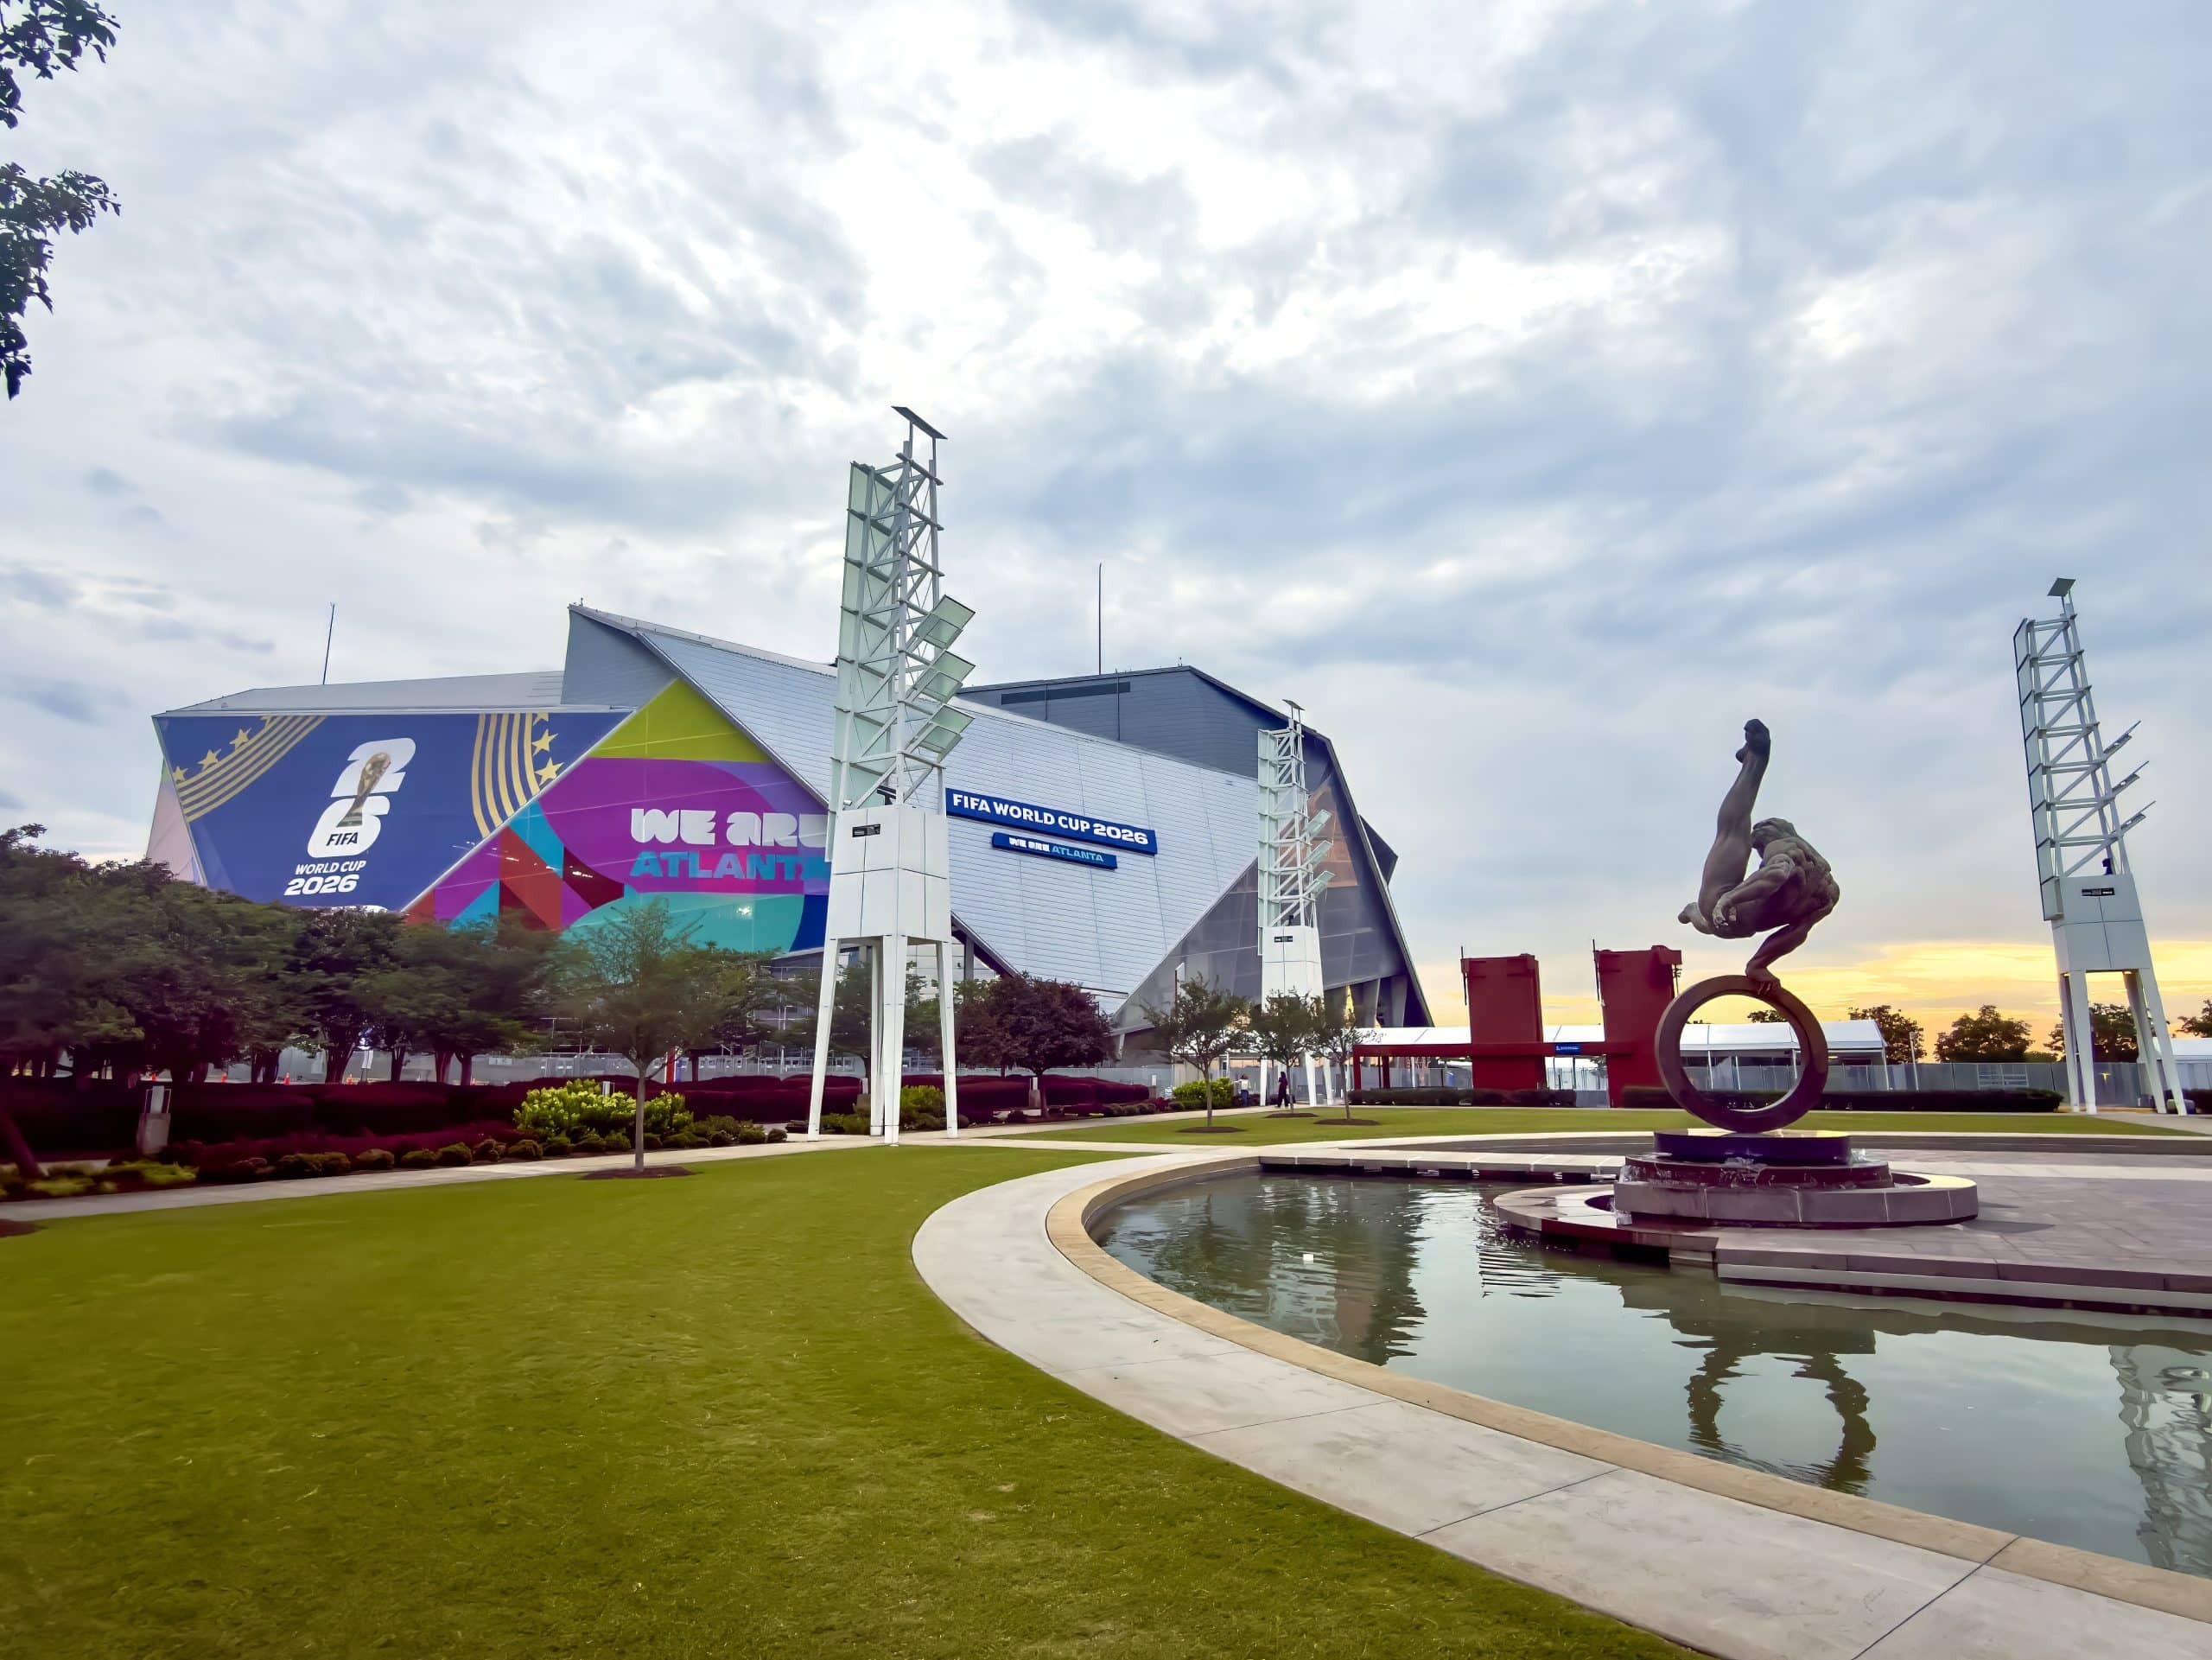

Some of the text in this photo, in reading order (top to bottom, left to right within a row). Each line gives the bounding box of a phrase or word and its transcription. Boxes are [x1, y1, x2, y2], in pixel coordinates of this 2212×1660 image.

[630, 808, 716, 845] WE
[952, 793, 1148, 845] FIFA WORLD CUP 2026
[326, 832, 359, 847] FIFA
[1052, 845, 1104, 862] ATLANTA
[295, 861, 367, 875] WORLD CUP
[283, 874, 360, 896] 2026
